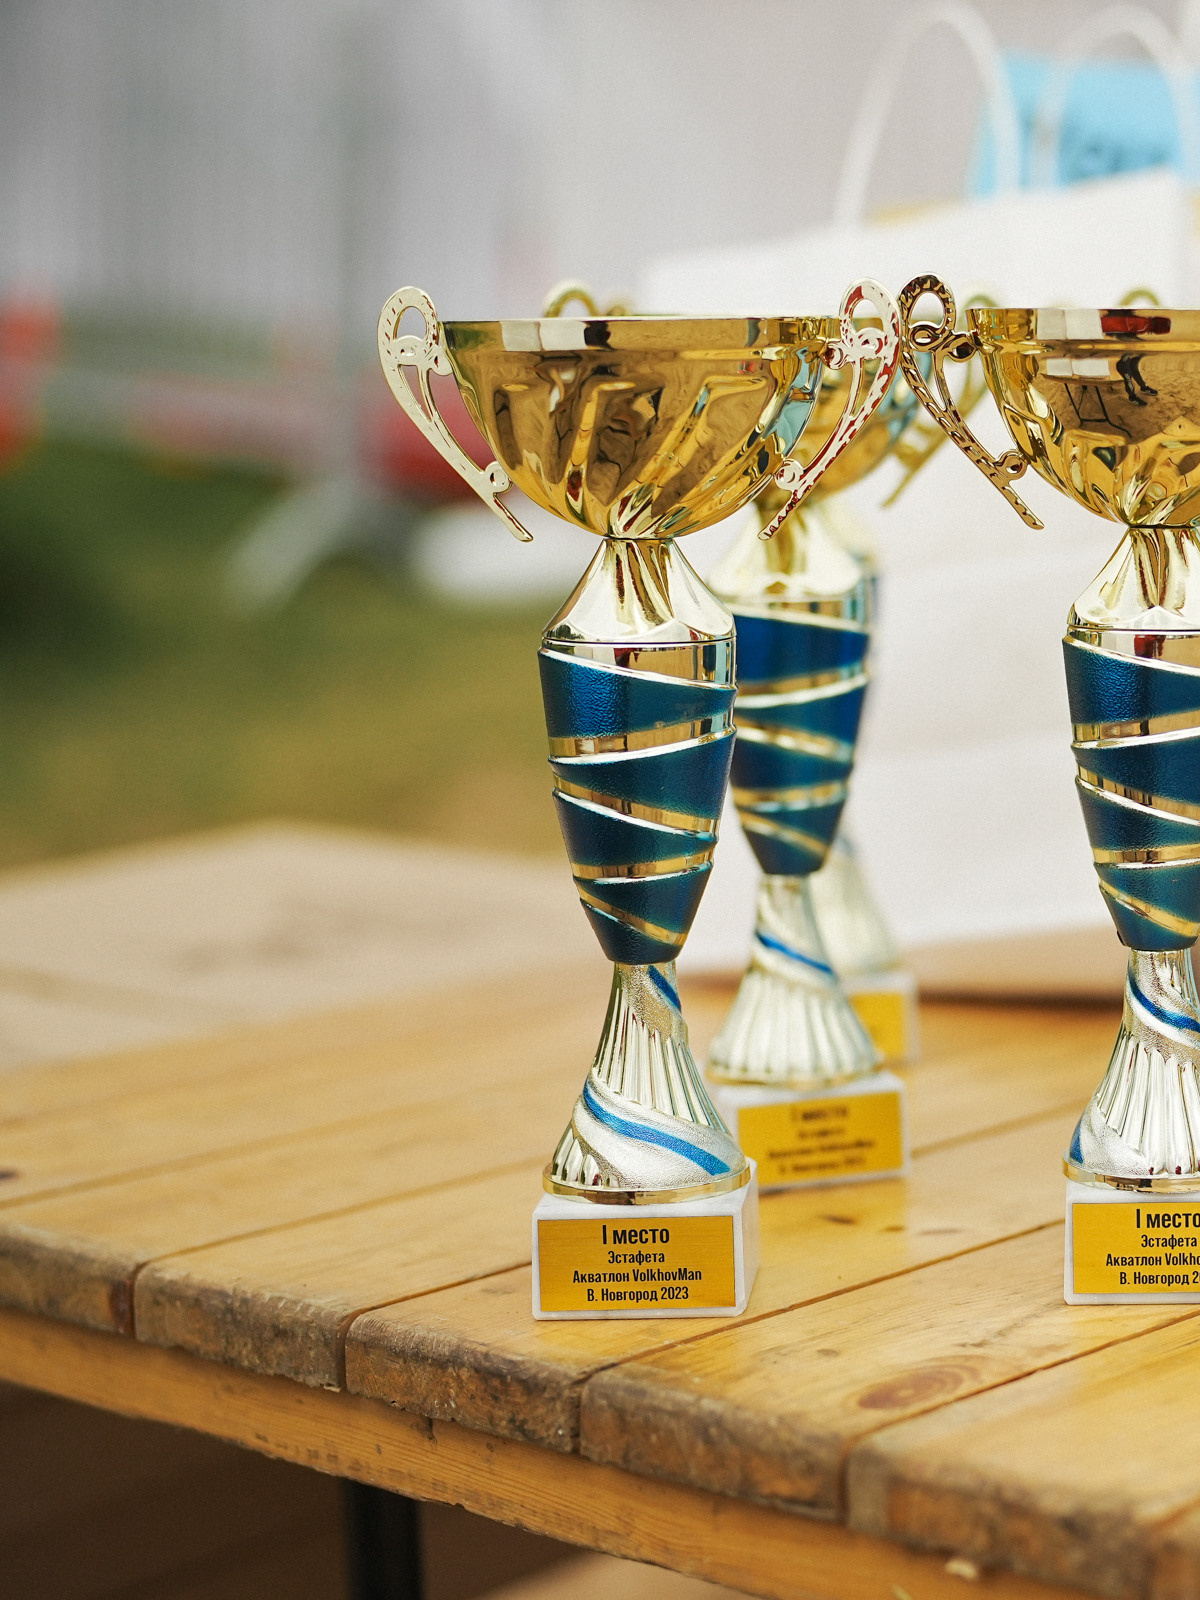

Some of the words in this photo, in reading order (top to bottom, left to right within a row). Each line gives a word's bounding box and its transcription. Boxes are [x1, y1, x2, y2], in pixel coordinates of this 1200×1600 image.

[612, 1228, 670, 1244] место
[1140, 1235, 1197, 1249] Эстафета
[607, 1251, 665, 1265] Эстафета
[1106, 1254, 1162, 1267] Акватлон
[573, 1270, 630, 1283] Акватлон
[632, 1268, 702, 1282] VolkhovMan
[1119, 1272, 1131, 1285] В.
[1133, 1272, 1190, 1286] Новгород
[587, 1289, 598, 1302] В.
[601, 1288, 658, 1302] Новгород
[660, 1287, 689, 1300] 2023
